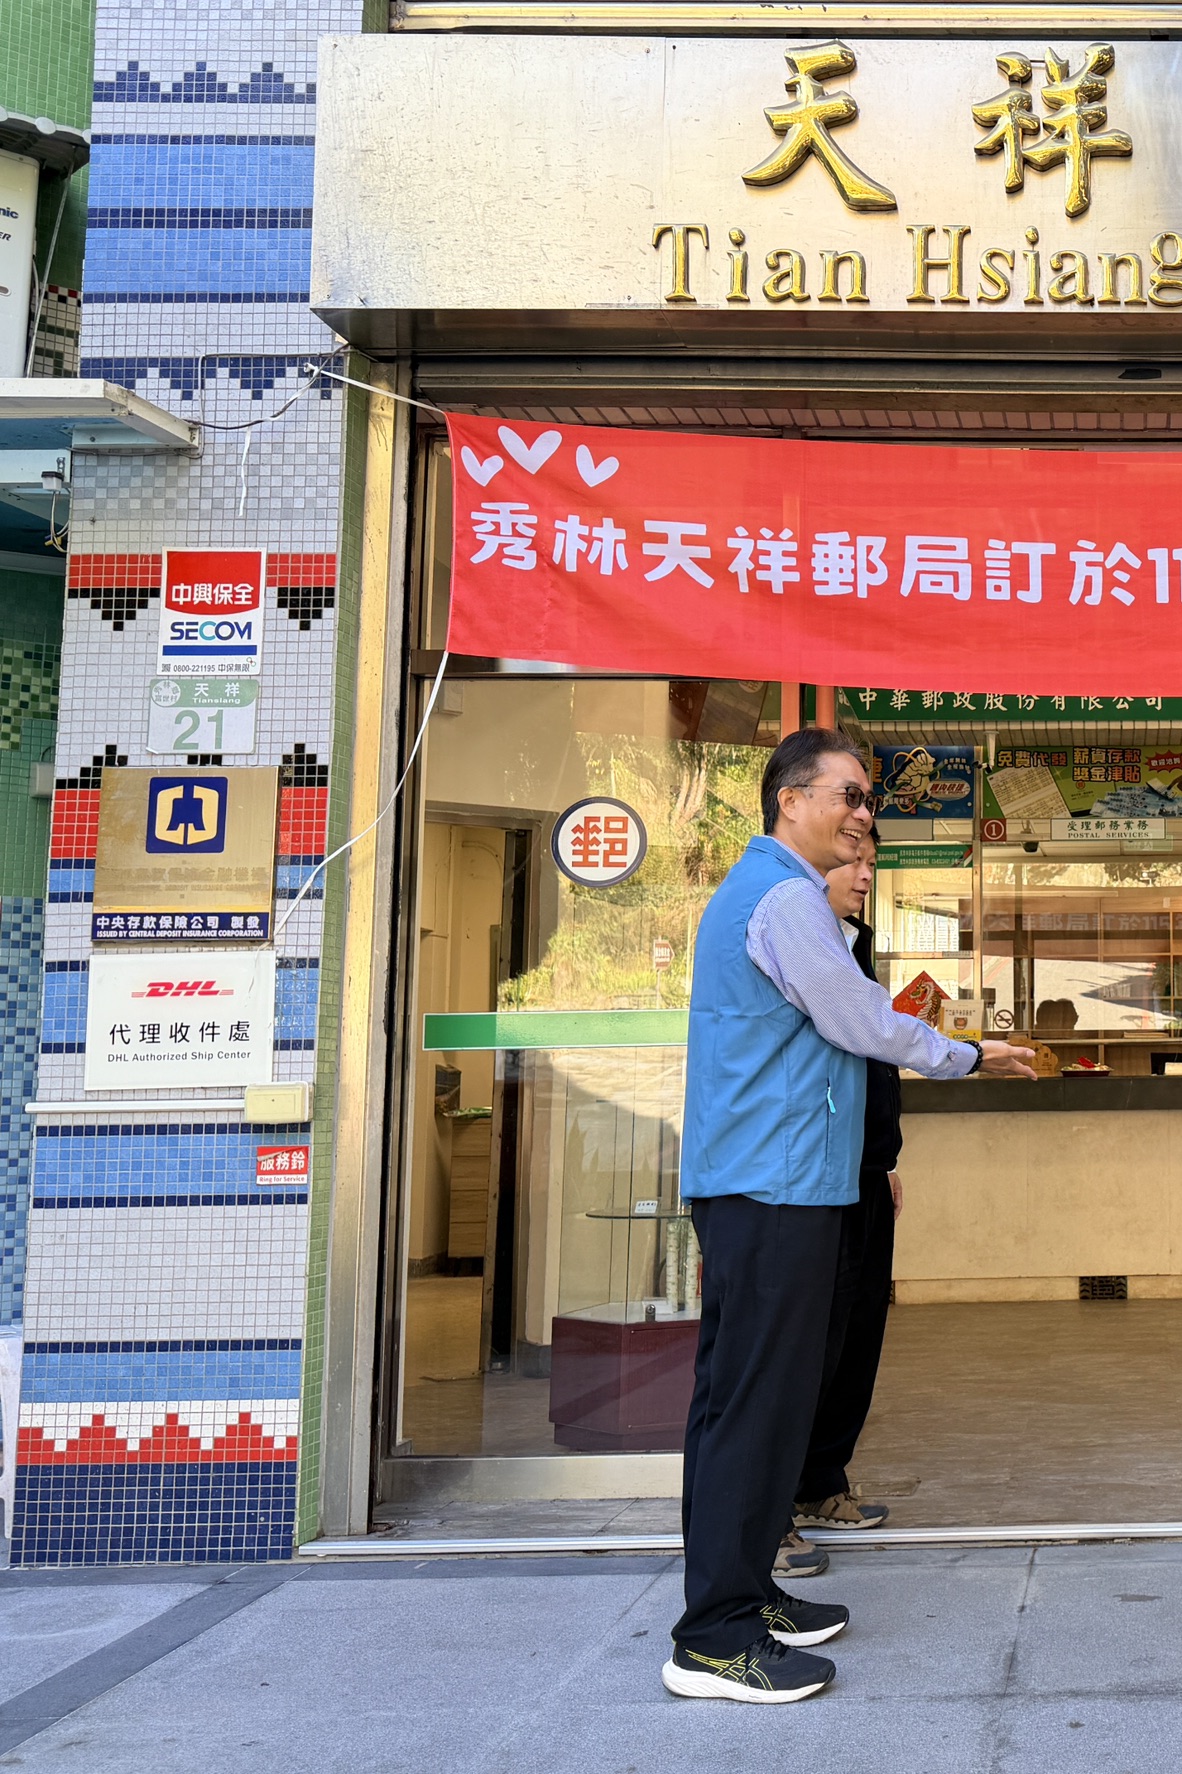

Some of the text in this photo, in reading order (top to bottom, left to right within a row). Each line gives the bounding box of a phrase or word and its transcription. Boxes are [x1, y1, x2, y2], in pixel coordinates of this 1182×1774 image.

[652, 223, 870, 302] Tian
[171, 583, 254, 605] 中興保全
[170, 621, 252, 640] SECOM
[194, 682, 240, 697] 天祥
[858, 687, 1163, 711] 中華郵政股份有限公司
[172, 709, 224, 750] 21
[997, 750, 1067, 768] 免費代發
[1073, 765, 1142, 783] 獎金津貼
[1067, 820, 1149, 832] 受理郵務業務
[97, 915, 220, 930] 中央存款保險公司
[119, 930, 127, 938] BY
[218, 930, 263, 938] CORPORATION
[145, 981, 220, 998] DHL
[109, 1020, 251, 1046] 代理收件處
[107, 1051, 251, 1062] DHL Authorized Ship Center
[260, 1150, 305, 1171] 服務鈴
